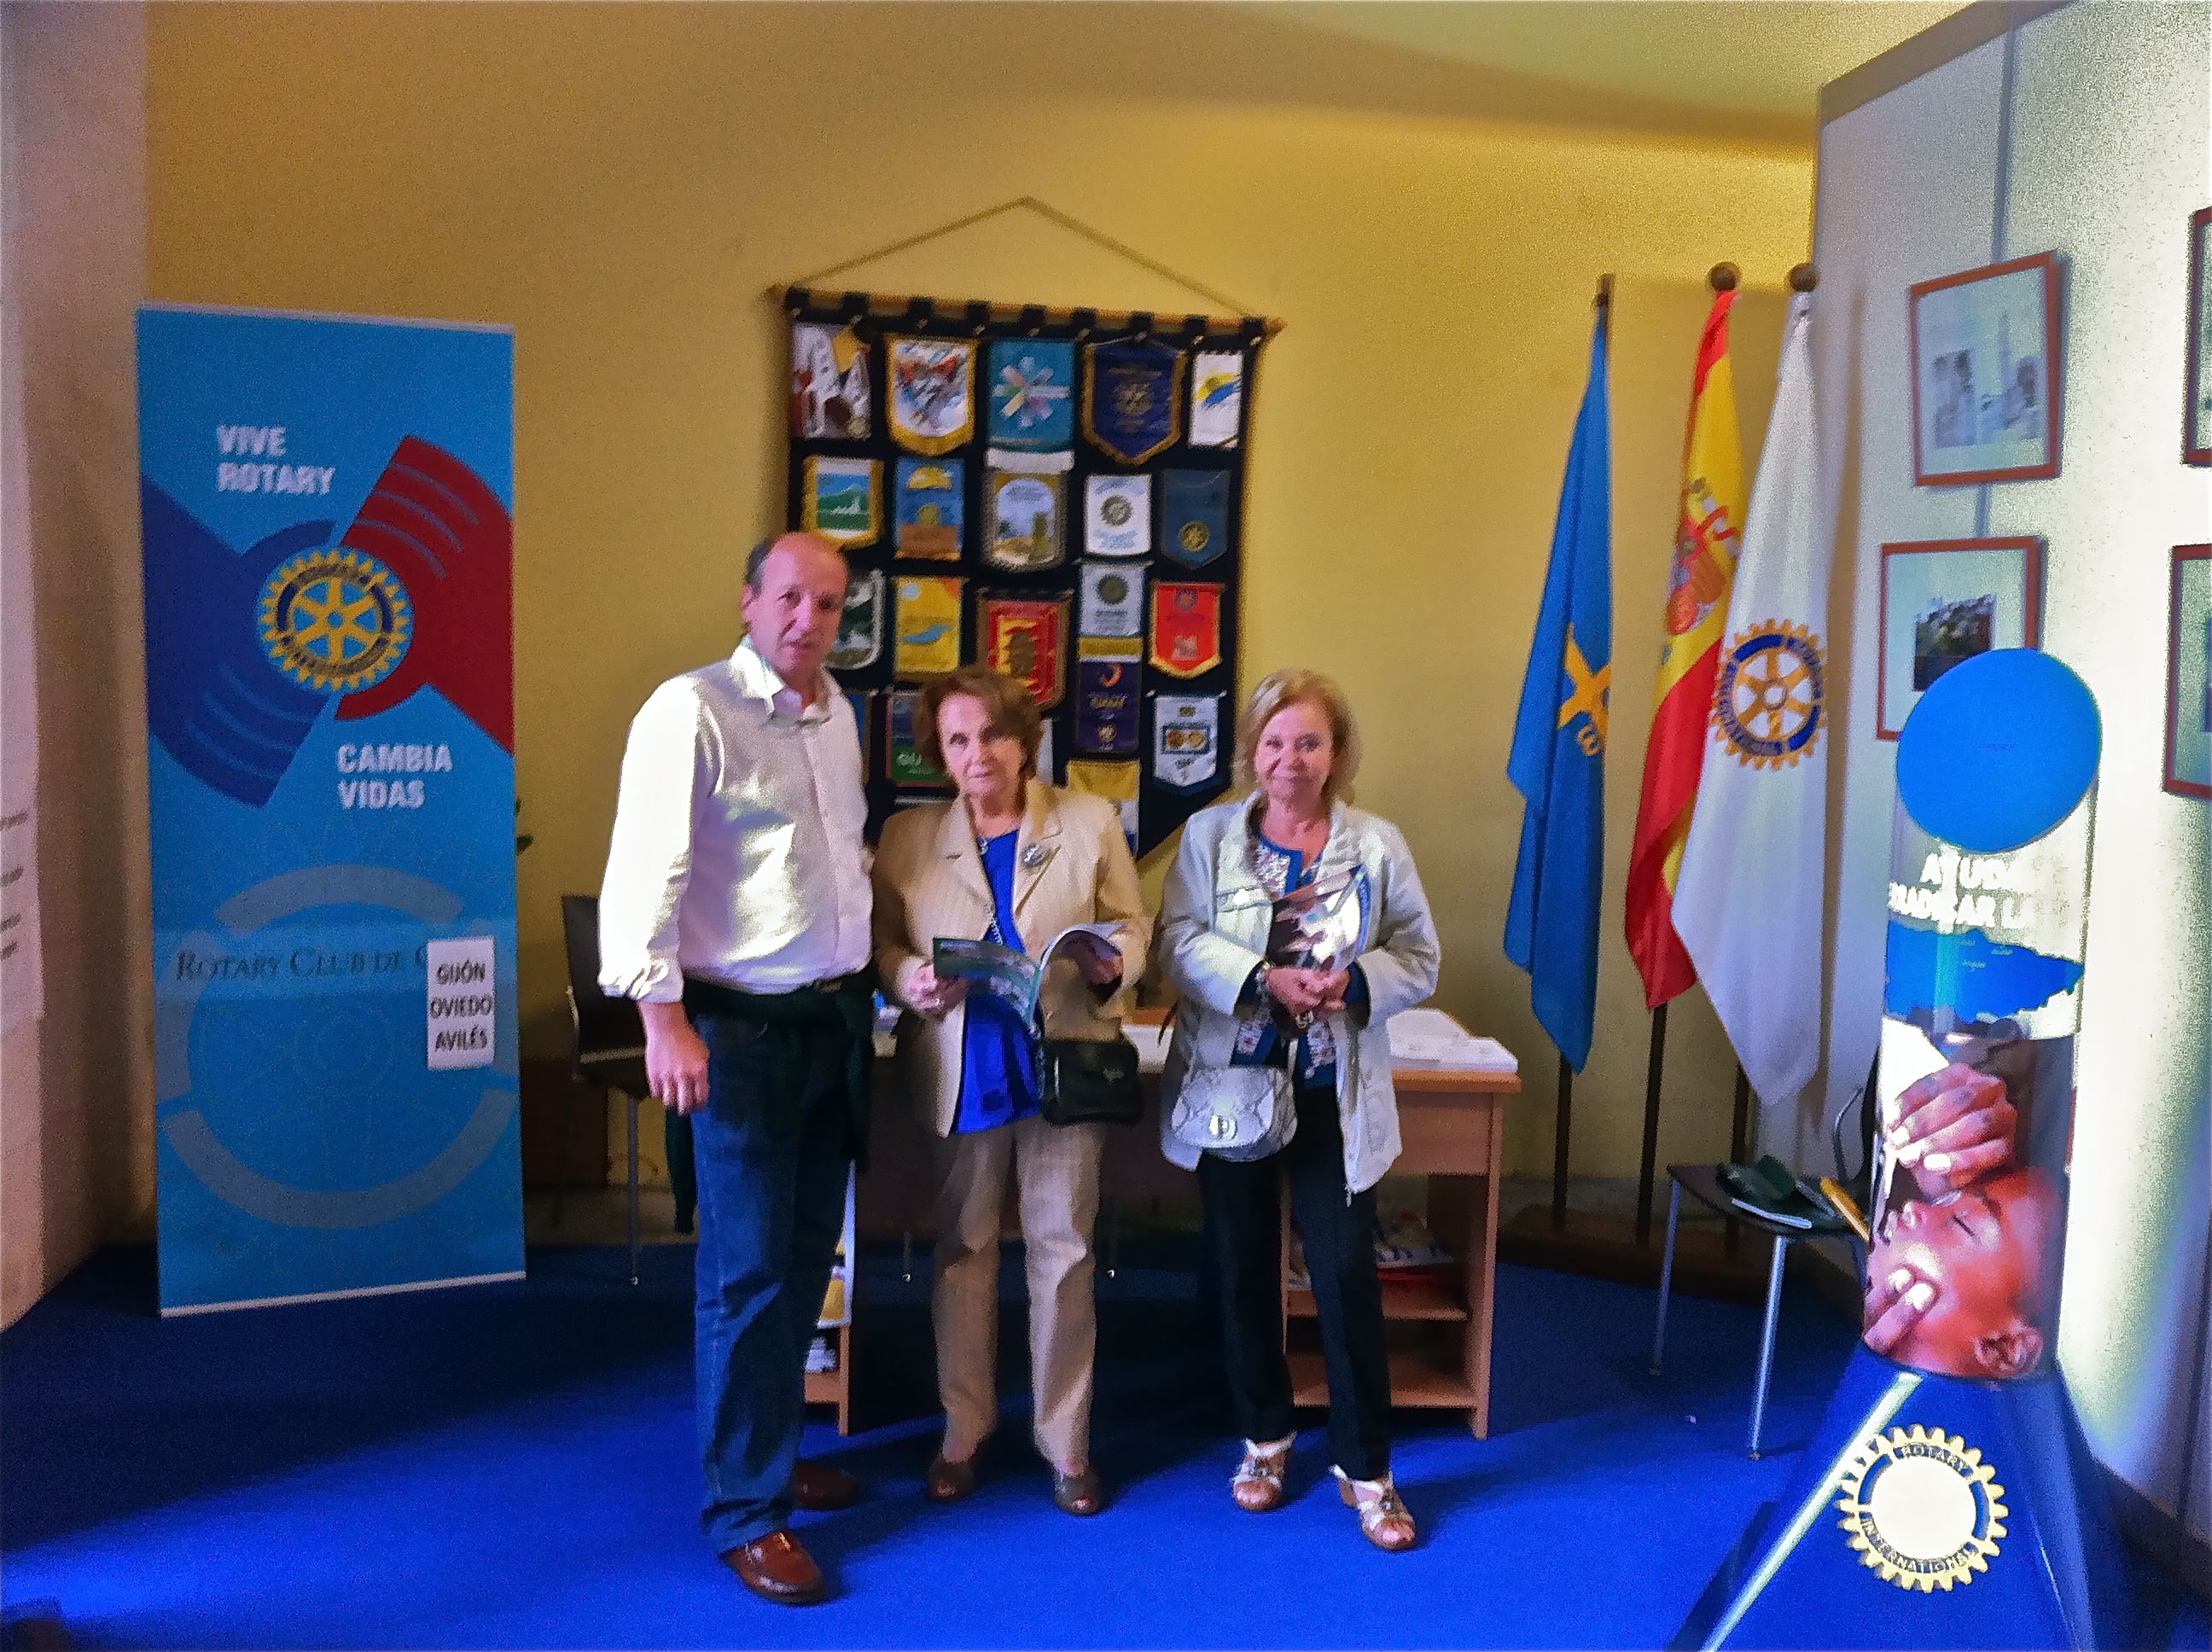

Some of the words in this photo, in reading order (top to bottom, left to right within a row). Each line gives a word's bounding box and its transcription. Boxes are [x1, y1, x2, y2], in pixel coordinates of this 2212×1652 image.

[217, 425, 288, 456] VIVE
[218, 462, 336, 495] ROTARY
[336, 742, 454, 773] CAMBIA
[338, 778, 426, 809] VIDAS
[176, 949, 280, 981] ROTARY
[289, 945, 366, 975] CLUB
[435, 957, 486, 985] GIJÓN
[429, 992, 492, 1019] OVIEDO
[434, 1025, 487, 1052] AVILÉS
[1900, 1443, 1970, 1474] ROTARY
